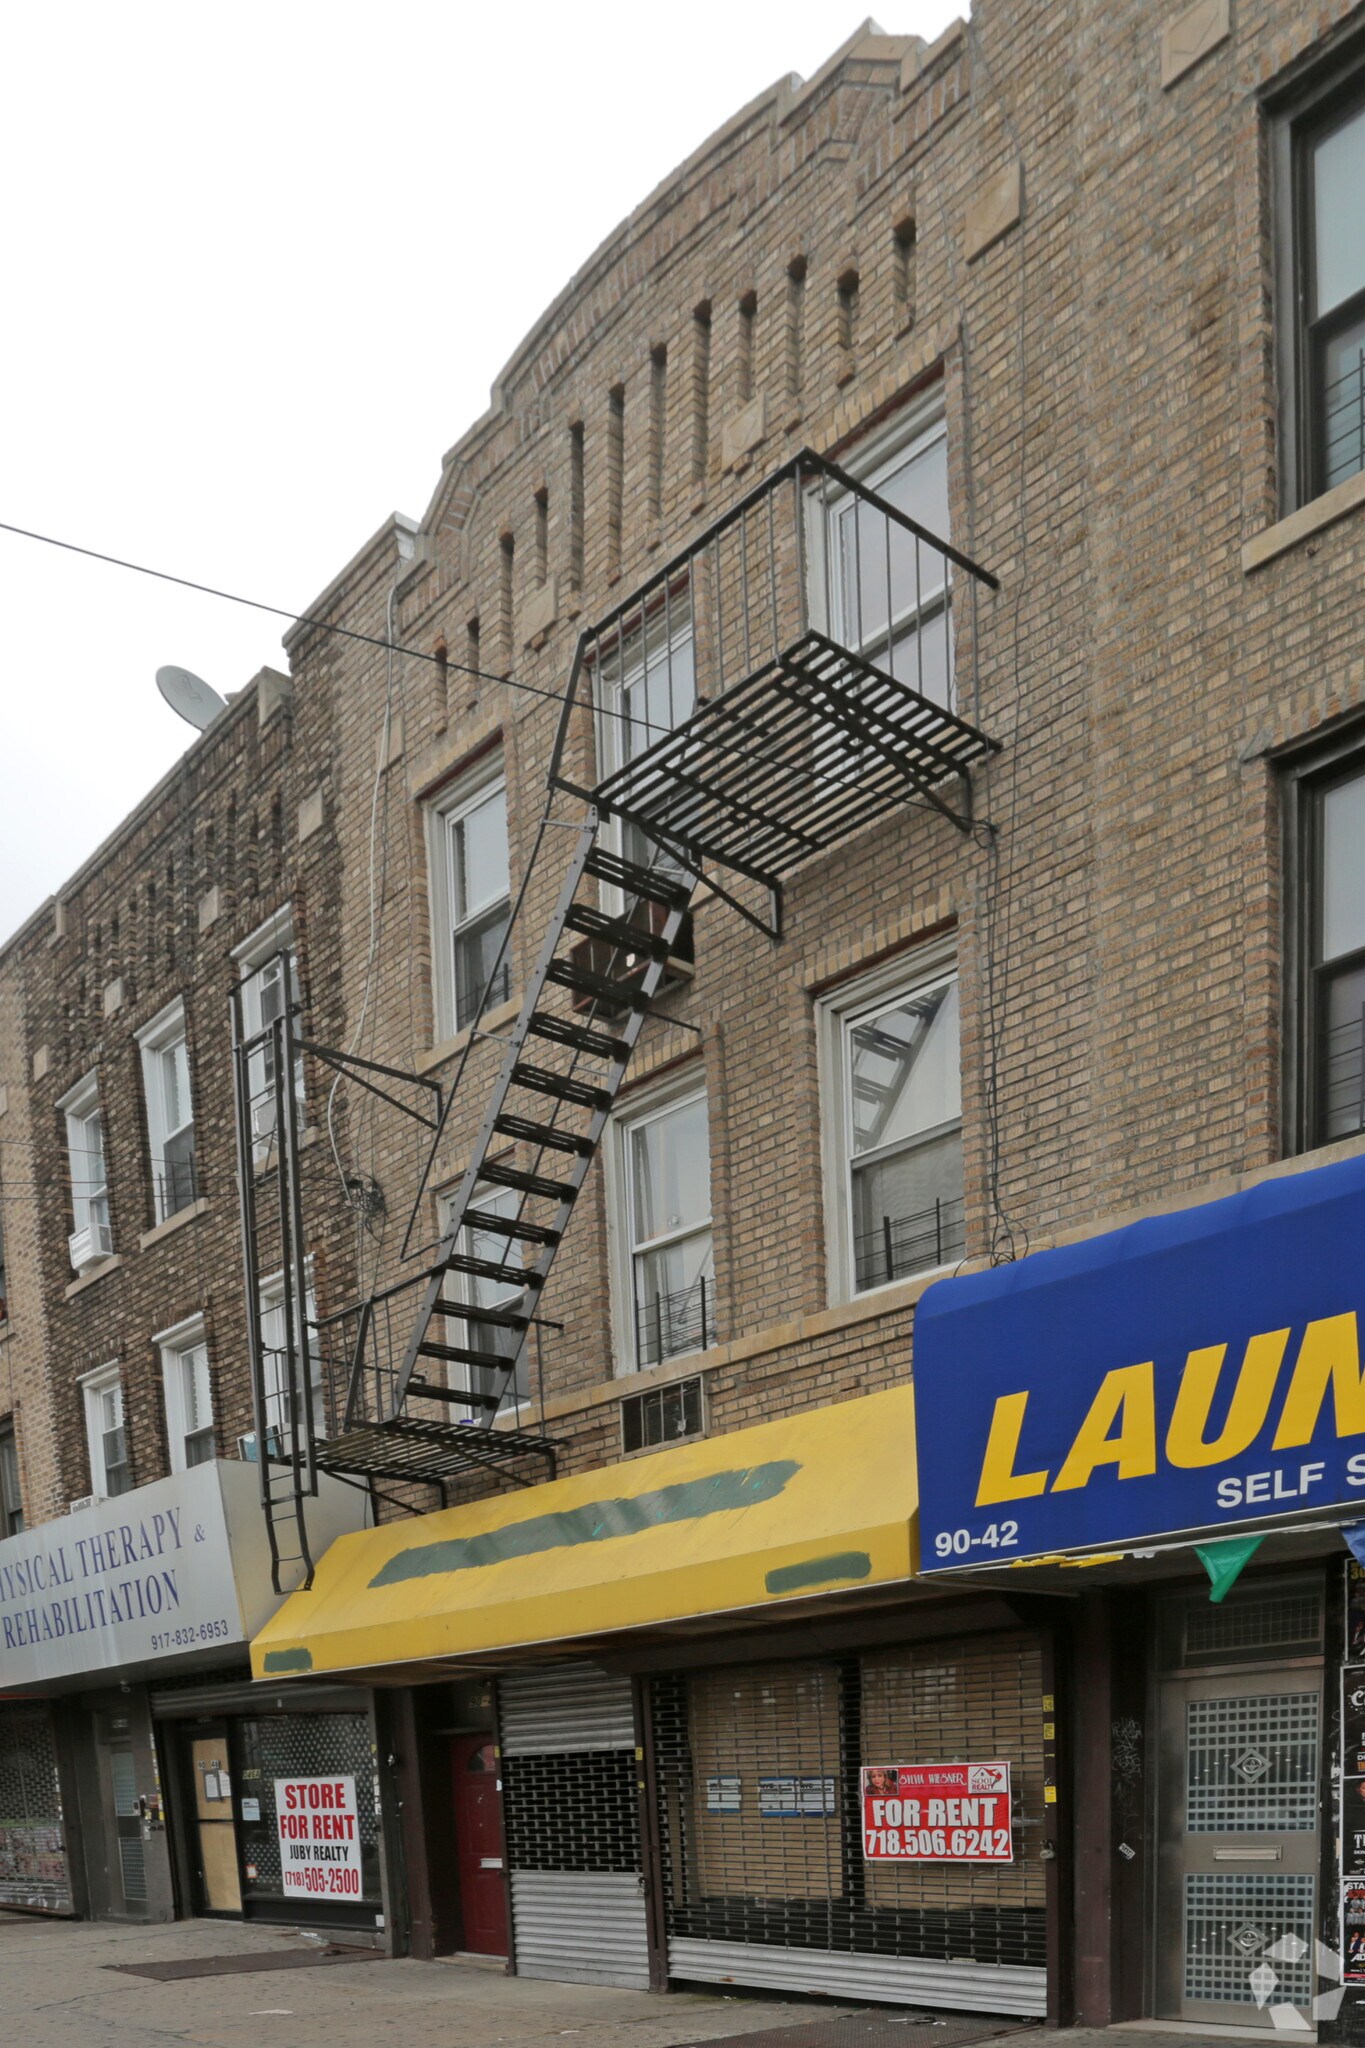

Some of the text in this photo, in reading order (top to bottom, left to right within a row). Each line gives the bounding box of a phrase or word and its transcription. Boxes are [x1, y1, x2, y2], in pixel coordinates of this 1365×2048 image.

[1217, 1462, 1325, 1509] SELF
[75, 1507, 183, 1578] THERAPY
[194, 1524, 206, 1543] &
[935, 1520, 1019, 1557] 90-42
[2, 1569, 181, 1649] REHABILITATION
[151, 1619, 229, 1650] 917-832-6953
[928, 1772, 968, 1786] WIESNER
[971, 1783, 994, 1791] REALTY
[285, 1783, 346, 1810] STORE
[872, 1797, 998, 1828] FOR RENT
[280, 1814, 355, 1841] FOR RENT
[290, 1844, 349, 1862] JUBY REALTY
[866, 1829, 1009, 1857] 718.506.6242
